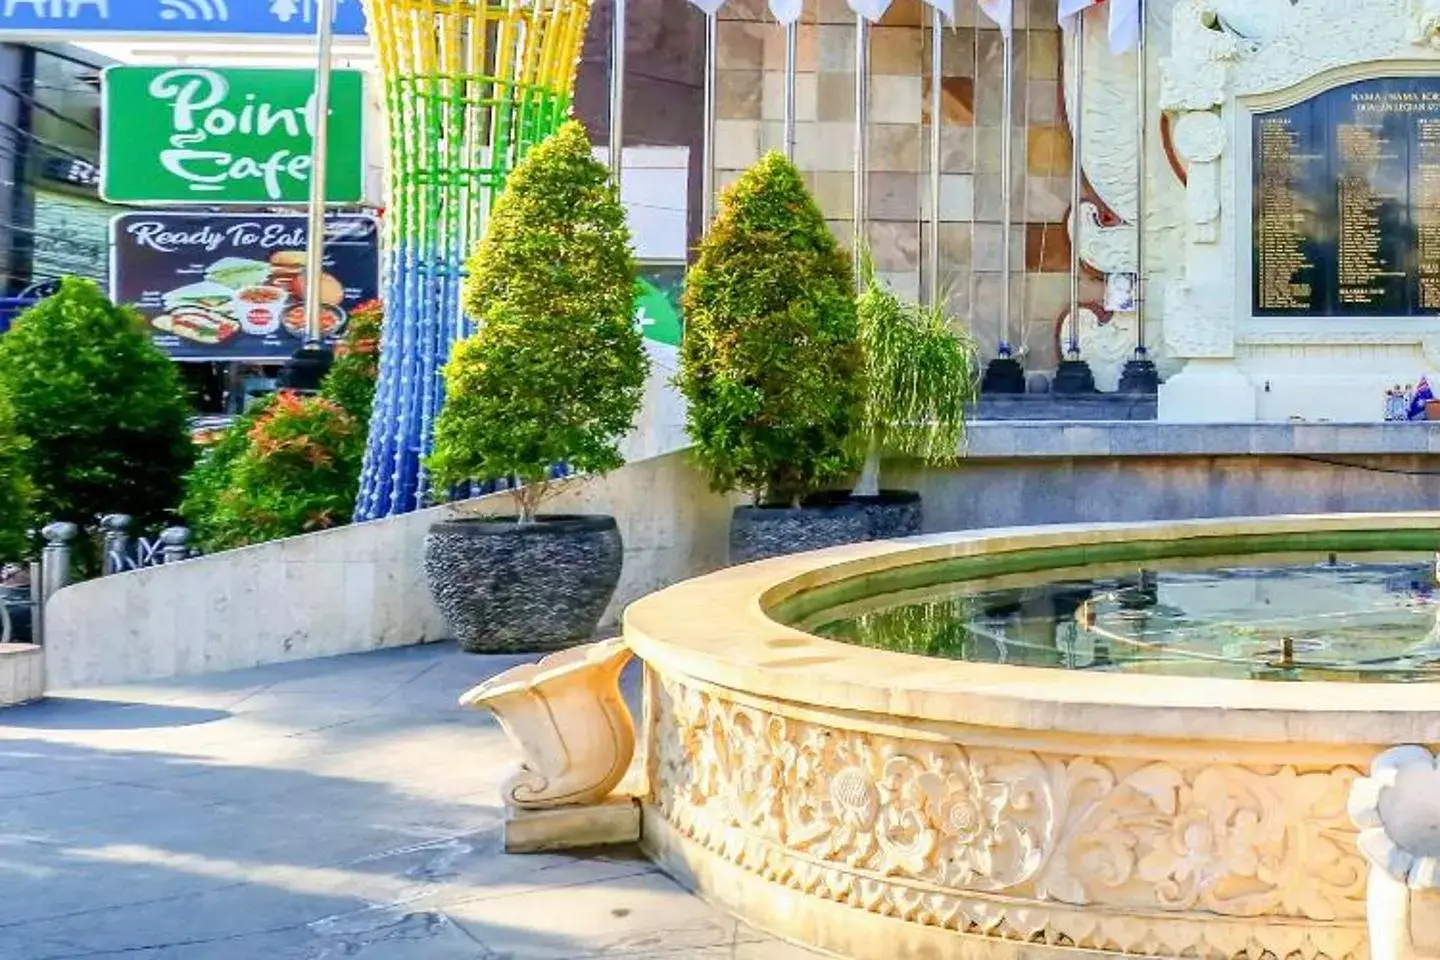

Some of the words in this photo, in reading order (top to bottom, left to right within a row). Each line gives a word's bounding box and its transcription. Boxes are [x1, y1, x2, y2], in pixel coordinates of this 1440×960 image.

[160, 149, 312, 200] Cafe
[127, 221, 226, 252] Ready
[225, 222, 260, 245] To
